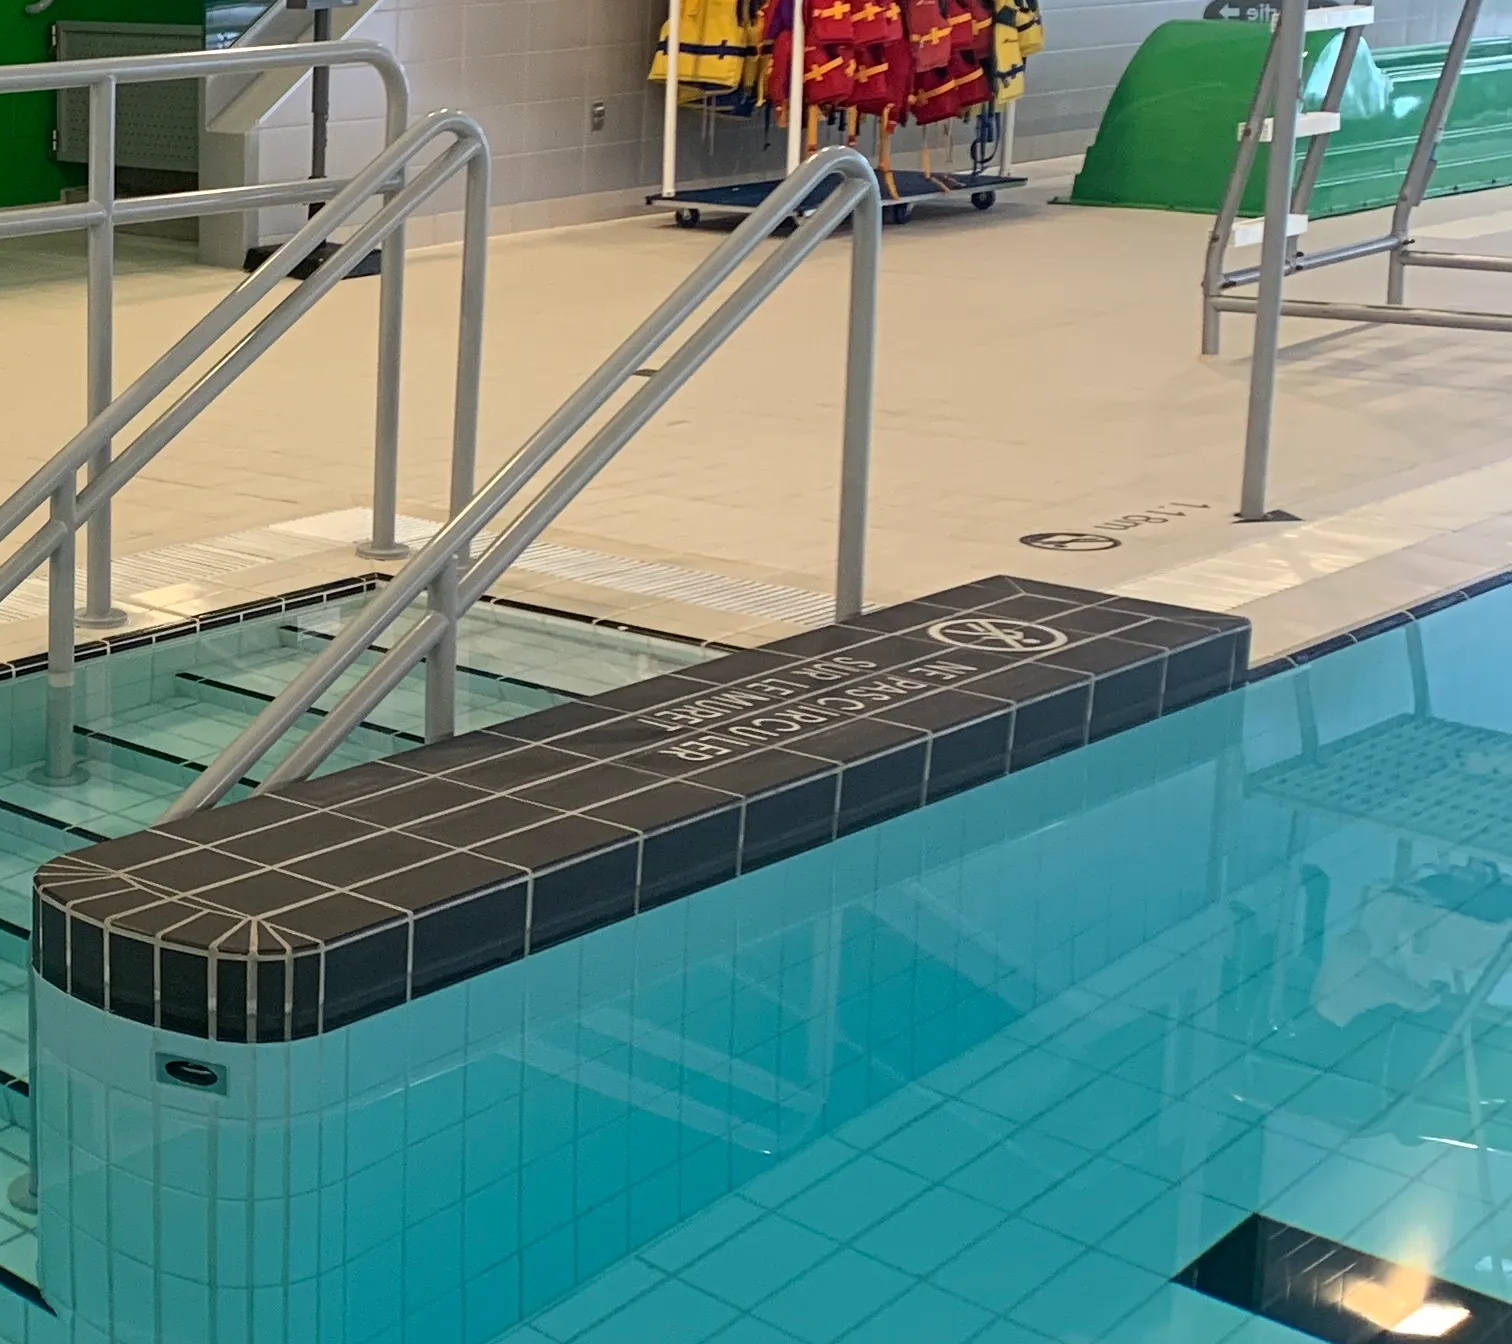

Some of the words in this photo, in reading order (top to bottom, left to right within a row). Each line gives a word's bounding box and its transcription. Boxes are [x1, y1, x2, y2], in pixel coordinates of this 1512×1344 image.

[1093, 502, 1210, 531] 1.18m
[791, 656, 877, 682] SUR
[908, 660, 978, 681] NE
[746, 677, 811, 698] LE
[845, 675, 928, 702] PAS
[637, 689, 771, 733] MURET
[658, 696, 866, 762] CIRCULER
